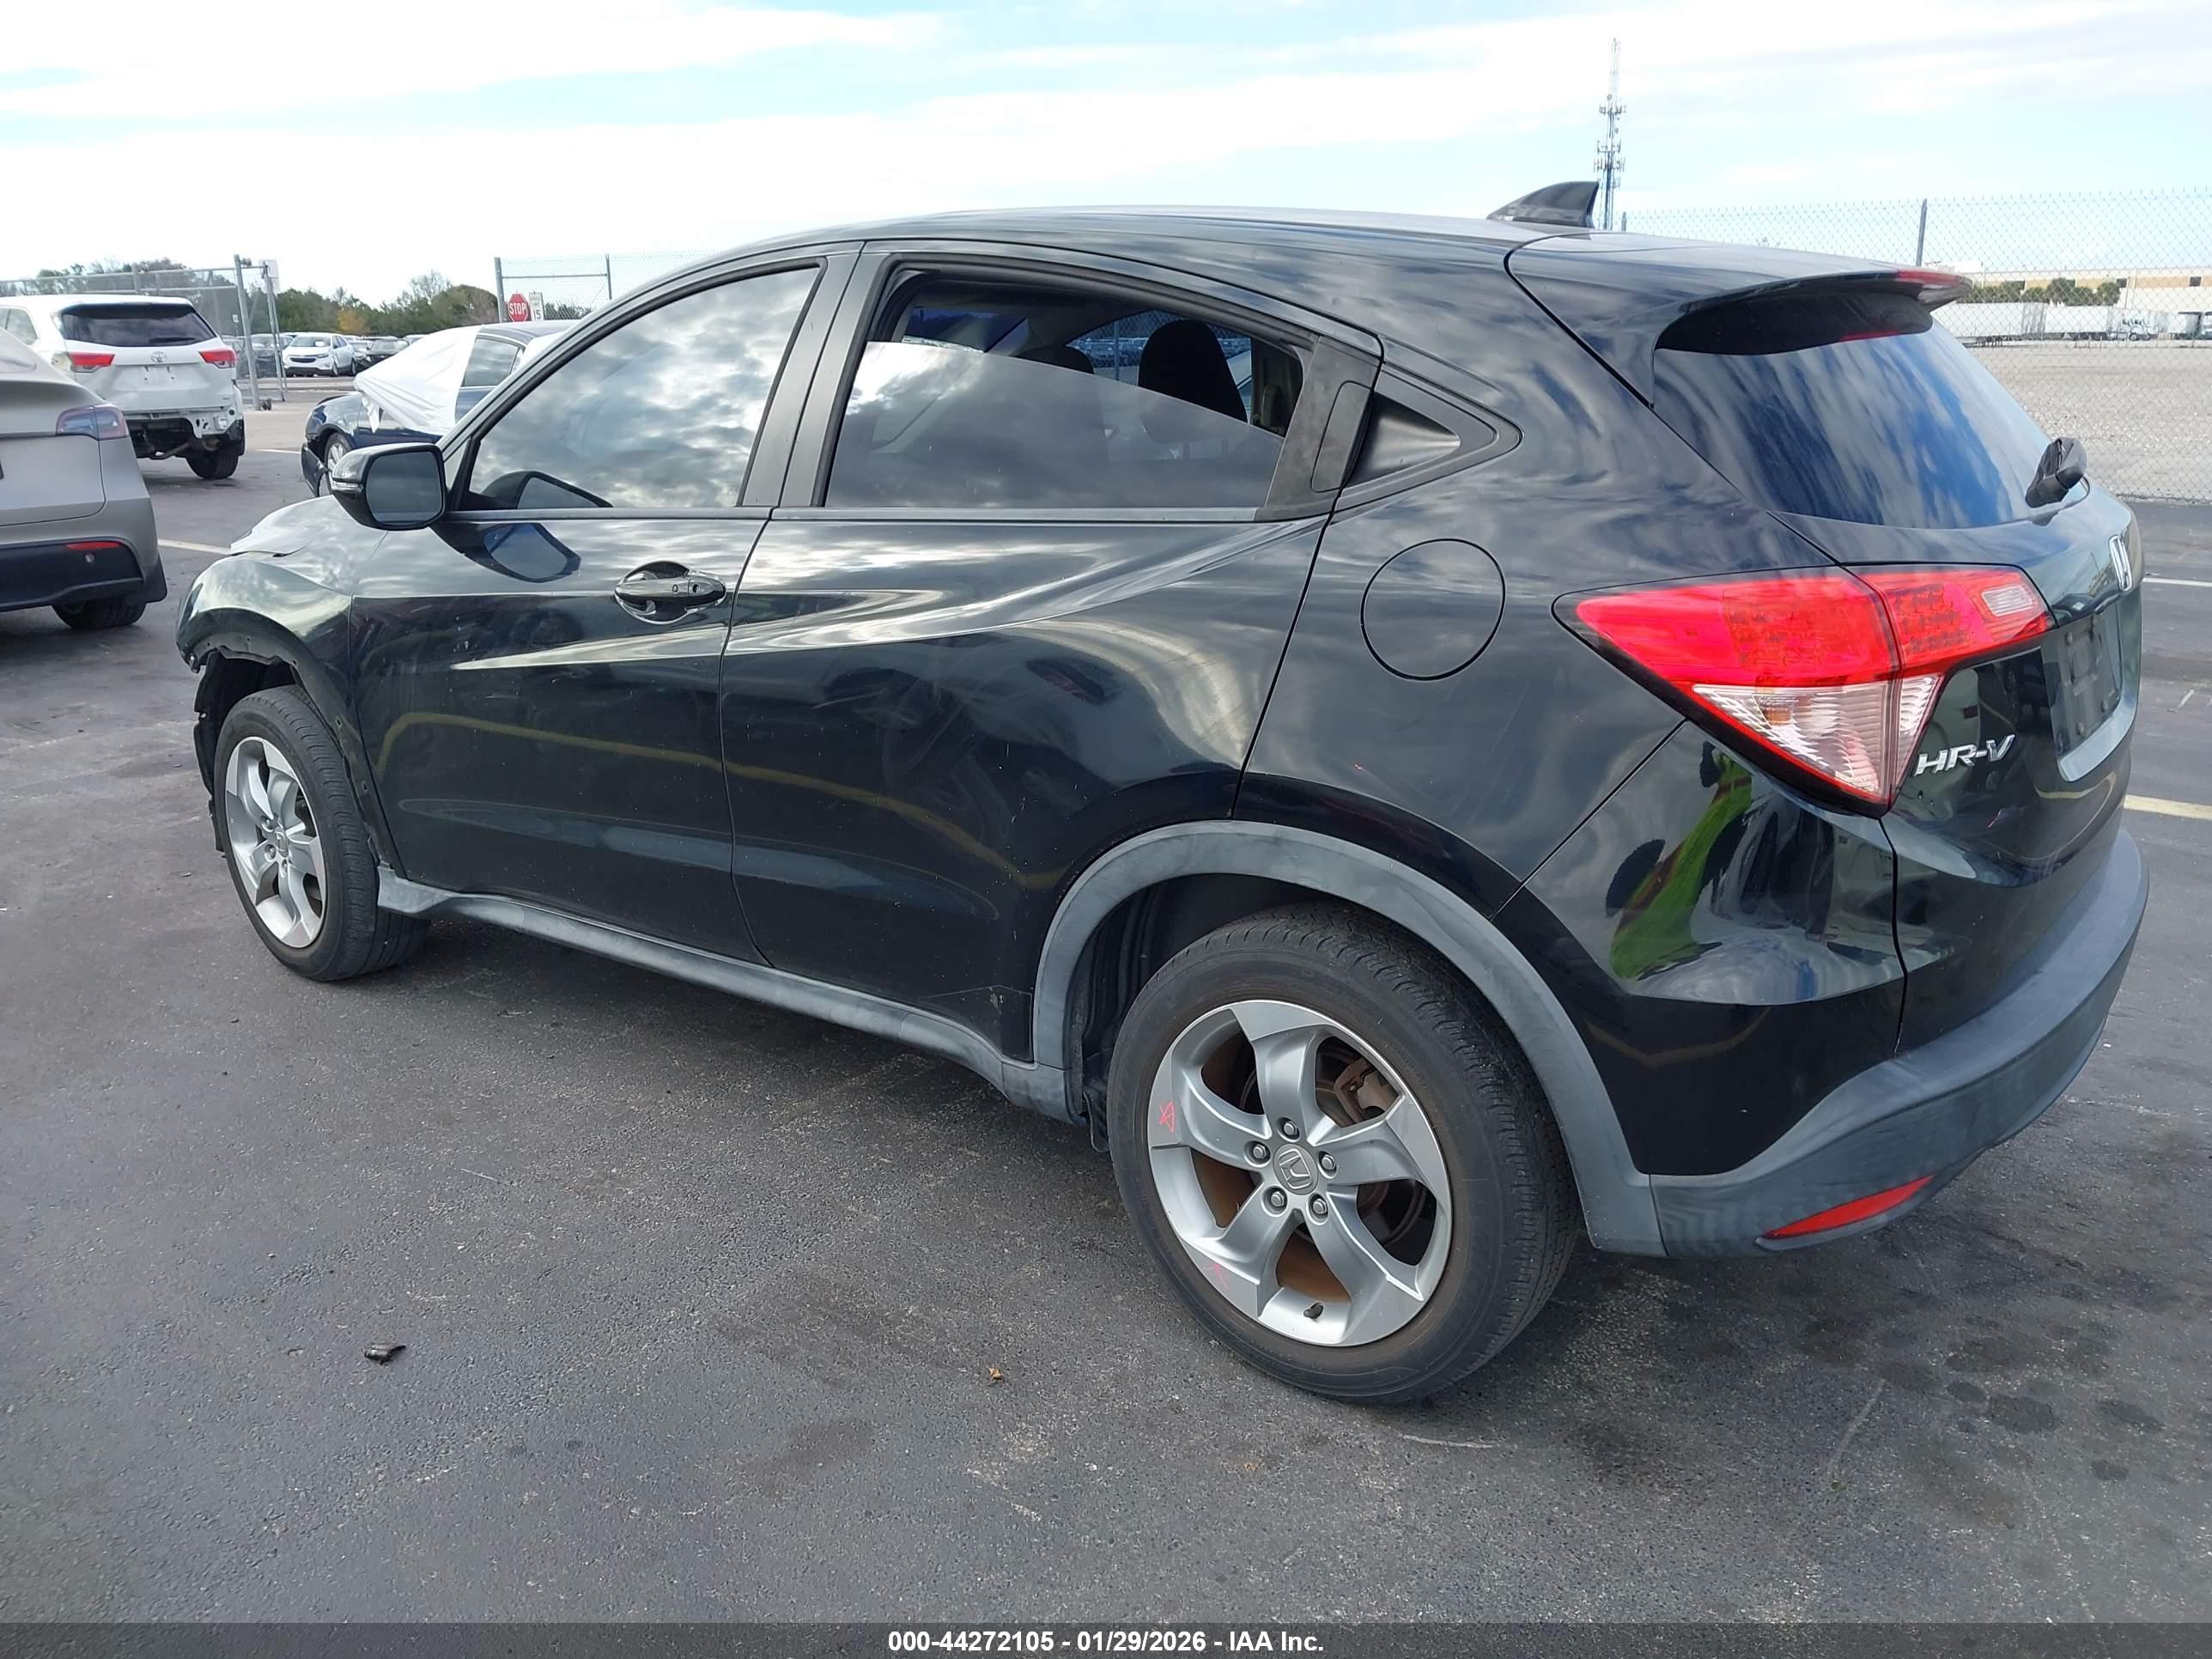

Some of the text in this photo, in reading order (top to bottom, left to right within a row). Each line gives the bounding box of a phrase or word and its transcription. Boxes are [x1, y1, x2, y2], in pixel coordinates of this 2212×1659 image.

[509, 302, 526, 315] STOP
[532, 309, 542, 320] 15
[1914, 734, 2015, 777] HR-V
